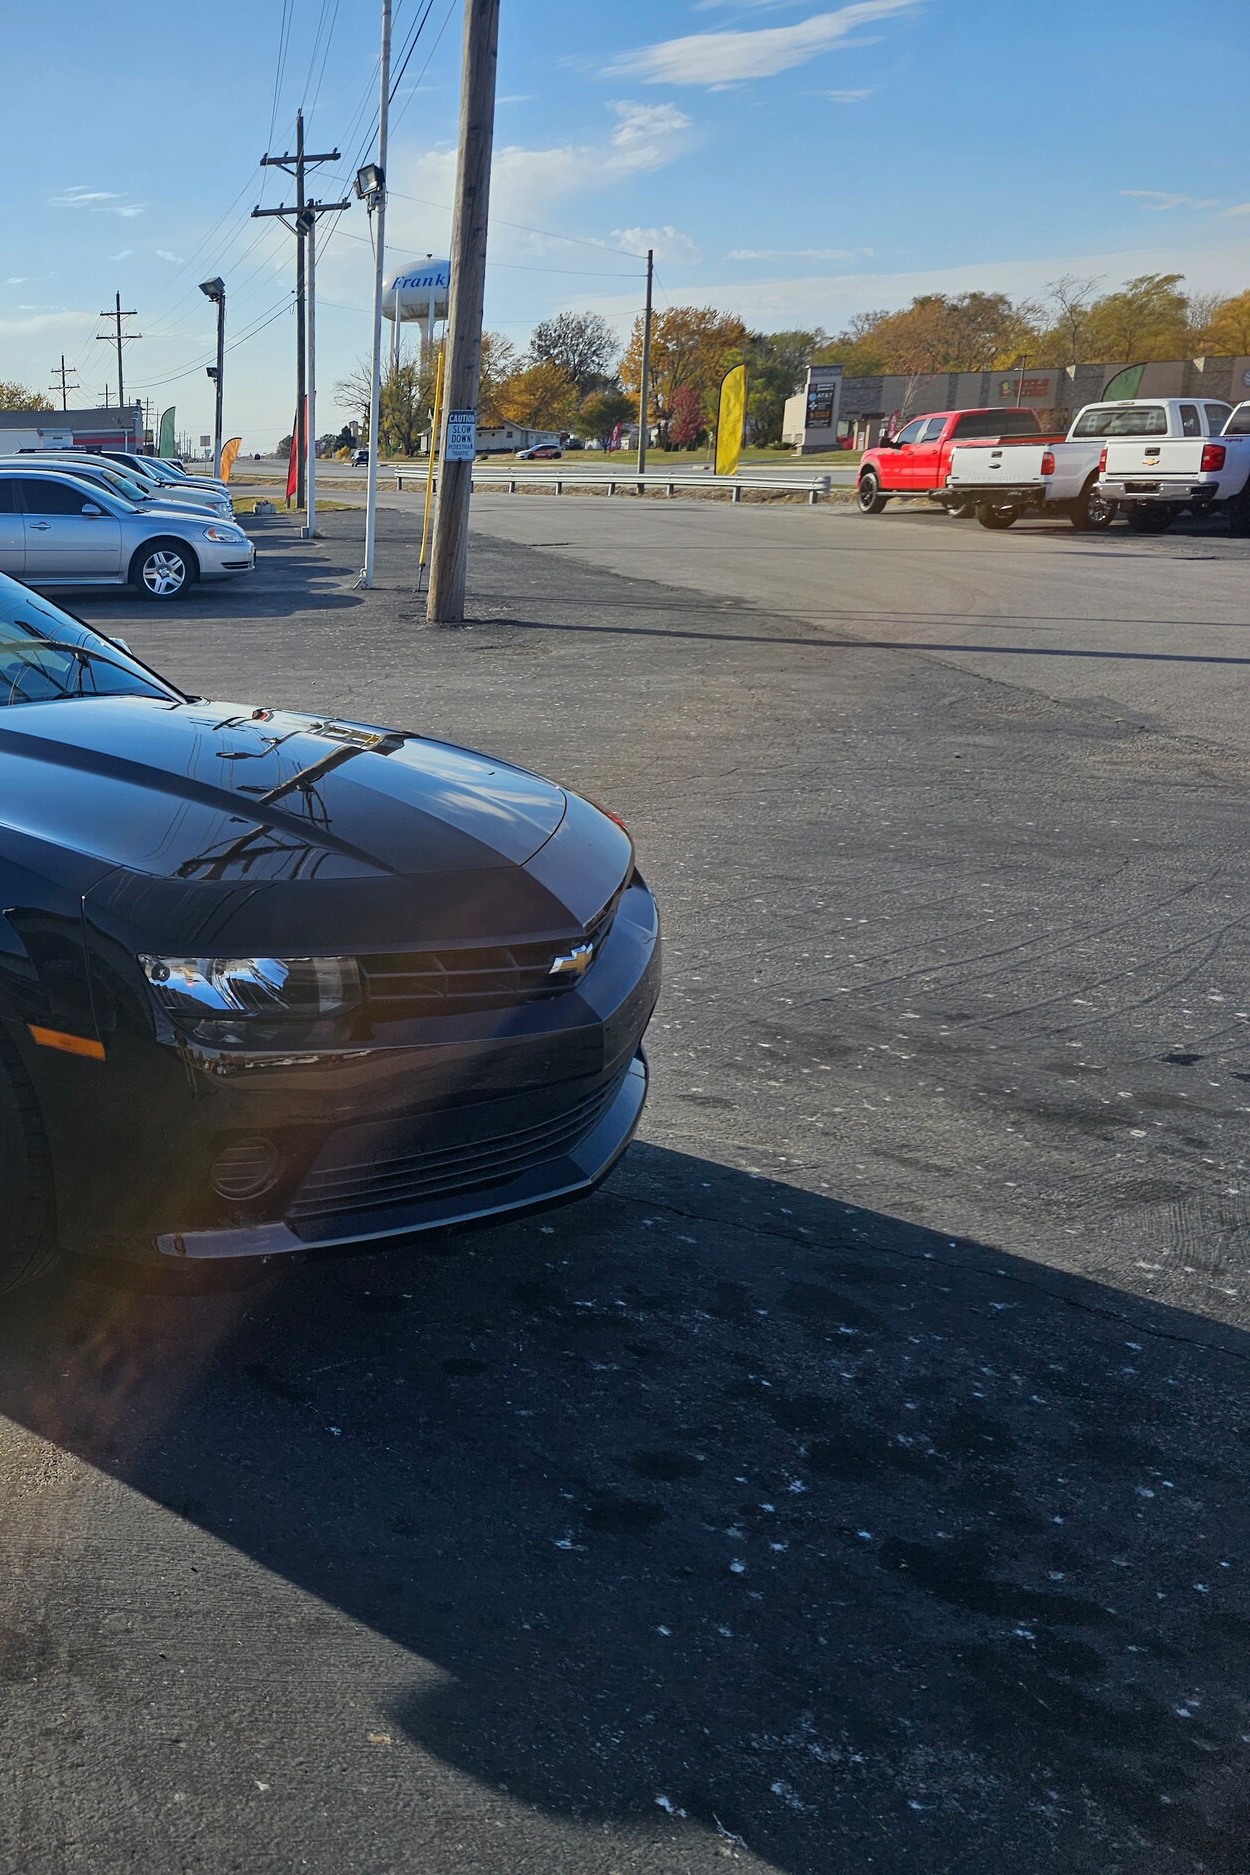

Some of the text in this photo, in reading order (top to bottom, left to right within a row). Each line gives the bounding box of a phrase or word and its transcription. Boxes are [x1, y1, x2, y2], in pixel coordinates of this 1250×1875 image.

[449, 414, 475, 423] CAUTION
[452, 424, 471, 434] SLOW
[451, 434, 472, 443] DOWN
